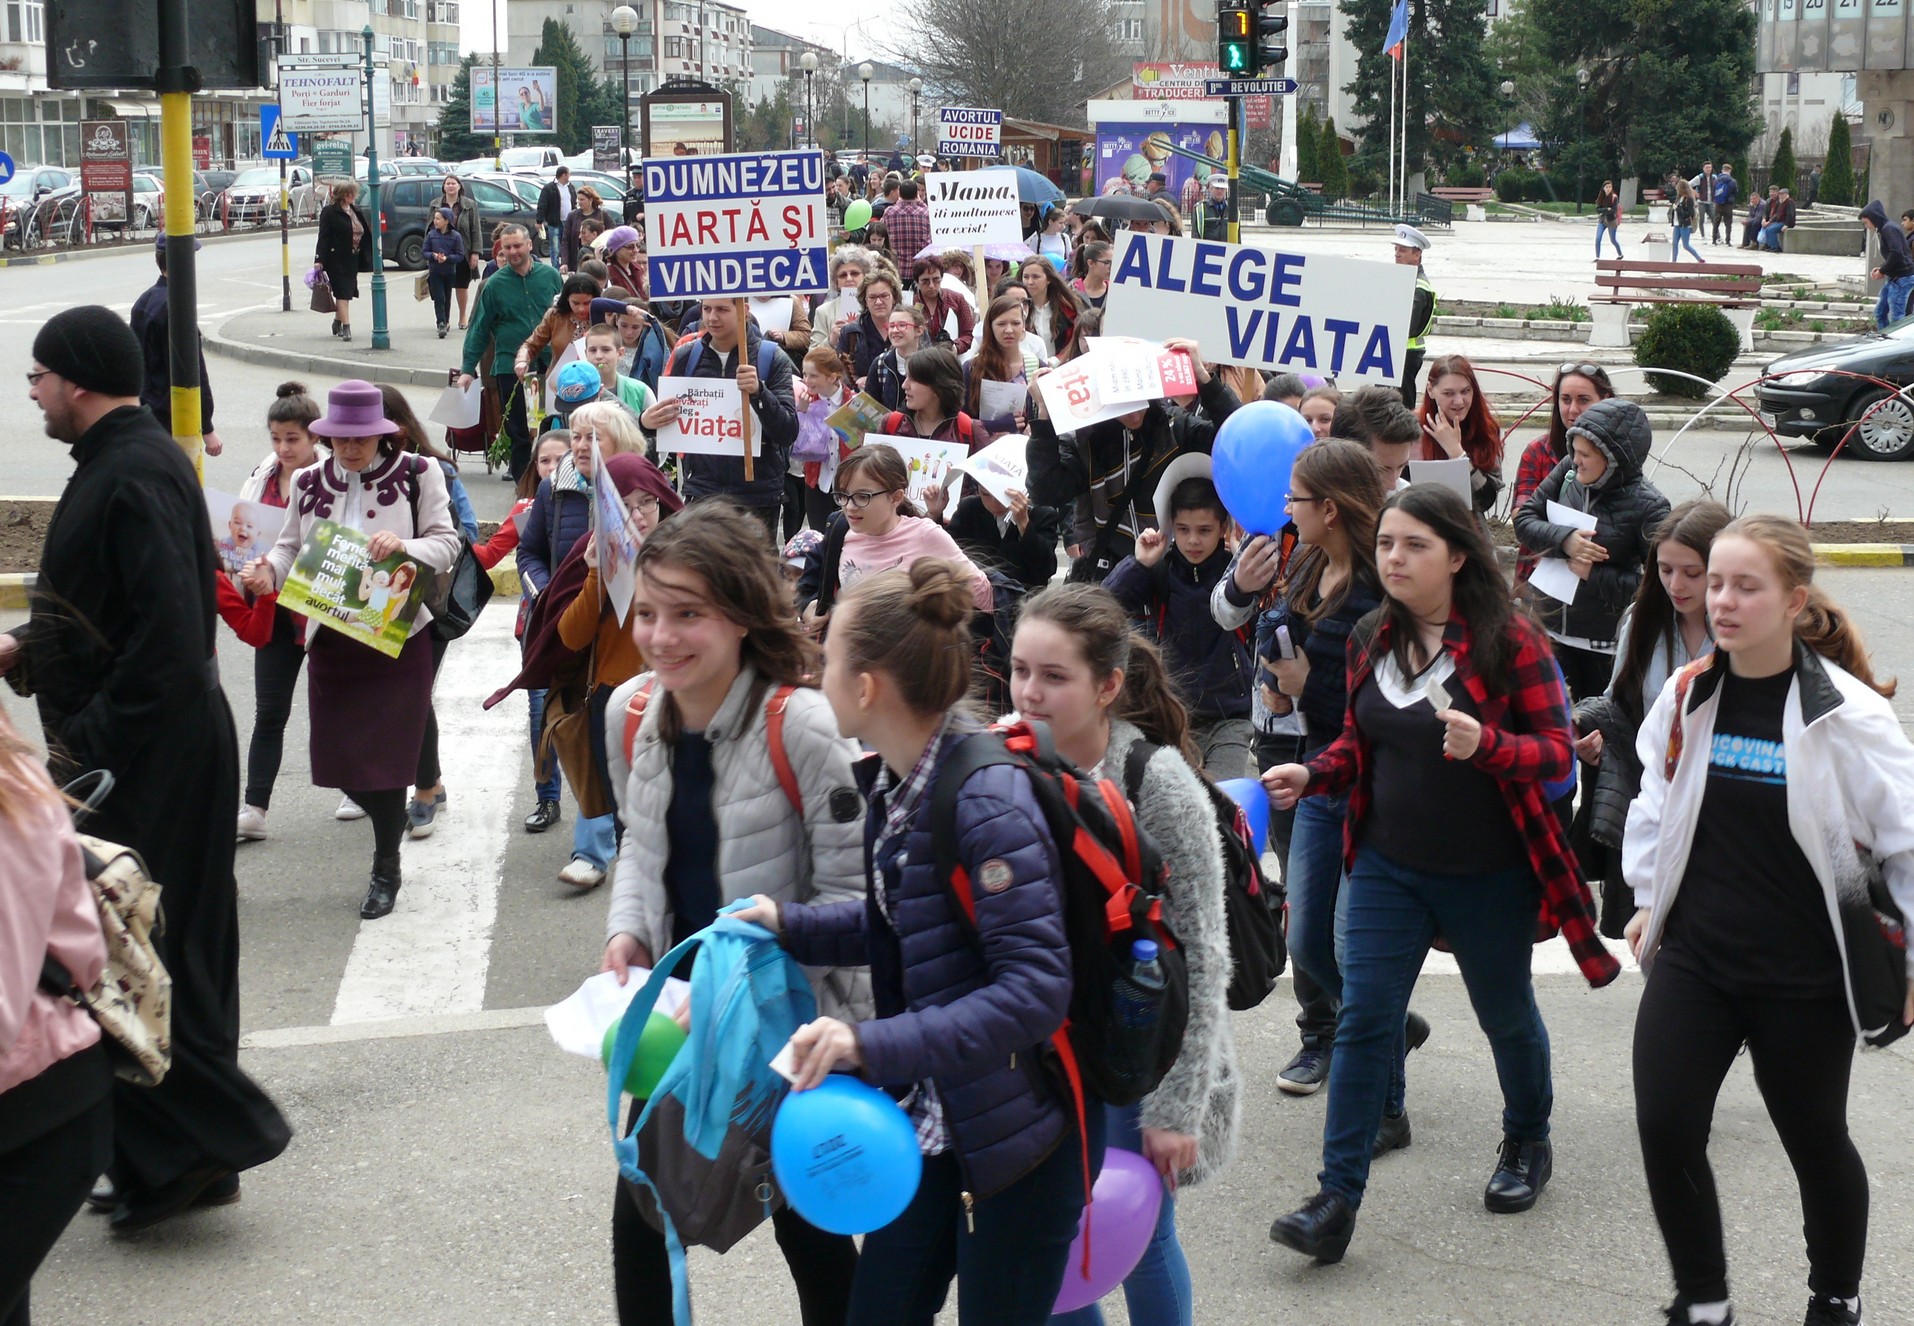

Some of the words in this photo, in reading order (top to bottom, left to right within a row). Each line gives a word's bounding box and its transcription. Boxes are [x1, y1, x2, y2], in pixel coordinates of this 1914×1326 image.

[283, 77, 357, 88] TEHNOFALT
[319, 89, 350, 97] Garduri
[302, 99, 317, 107] Fier
[319, 99, 341, 108] forjat
[943, 110, 998, 124] AVORTUL
[949, 125, 993, 140] UCIDE
[646, 157, 822, 198] DUMNEZEU
[658, 199, 770, 247] IARTĂ
[658, 247, 818, 293] VINDECĂ
[1113, 234, 1306, 307] ALEGE
[679, 406, 694, 416] leg
[677, 411, 742, 443] viața
[321, 560, 347, 577] mai
[316, 570, 347, 593] mult
[304, 596, 350, 623] avortul
